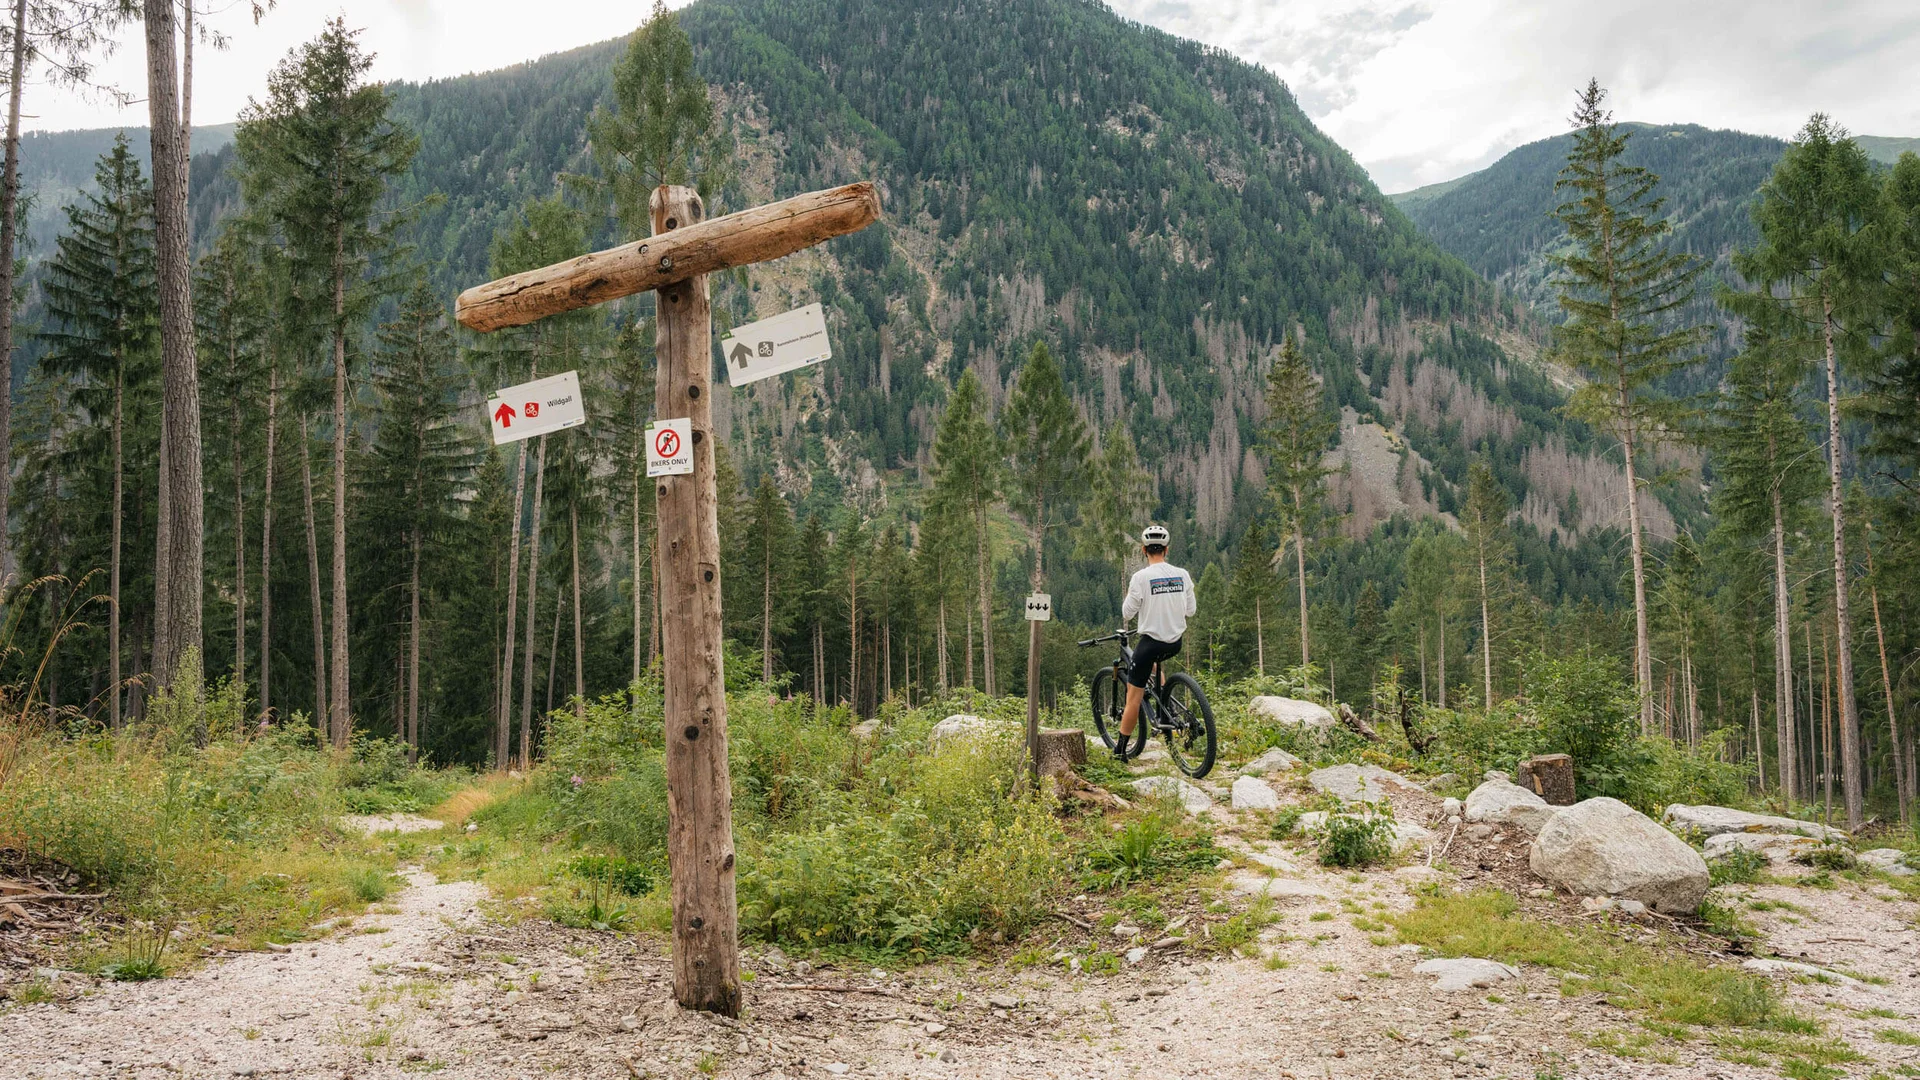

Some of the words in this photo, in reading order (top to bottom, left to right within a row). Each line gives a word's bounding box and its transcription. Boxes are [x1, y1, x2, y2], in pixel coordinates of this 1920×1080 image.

[547, 395, 573, 408] Wildgall
[671, 458, 688, 466] ONLY
[1152, 584, 1183, 594] patagonia
